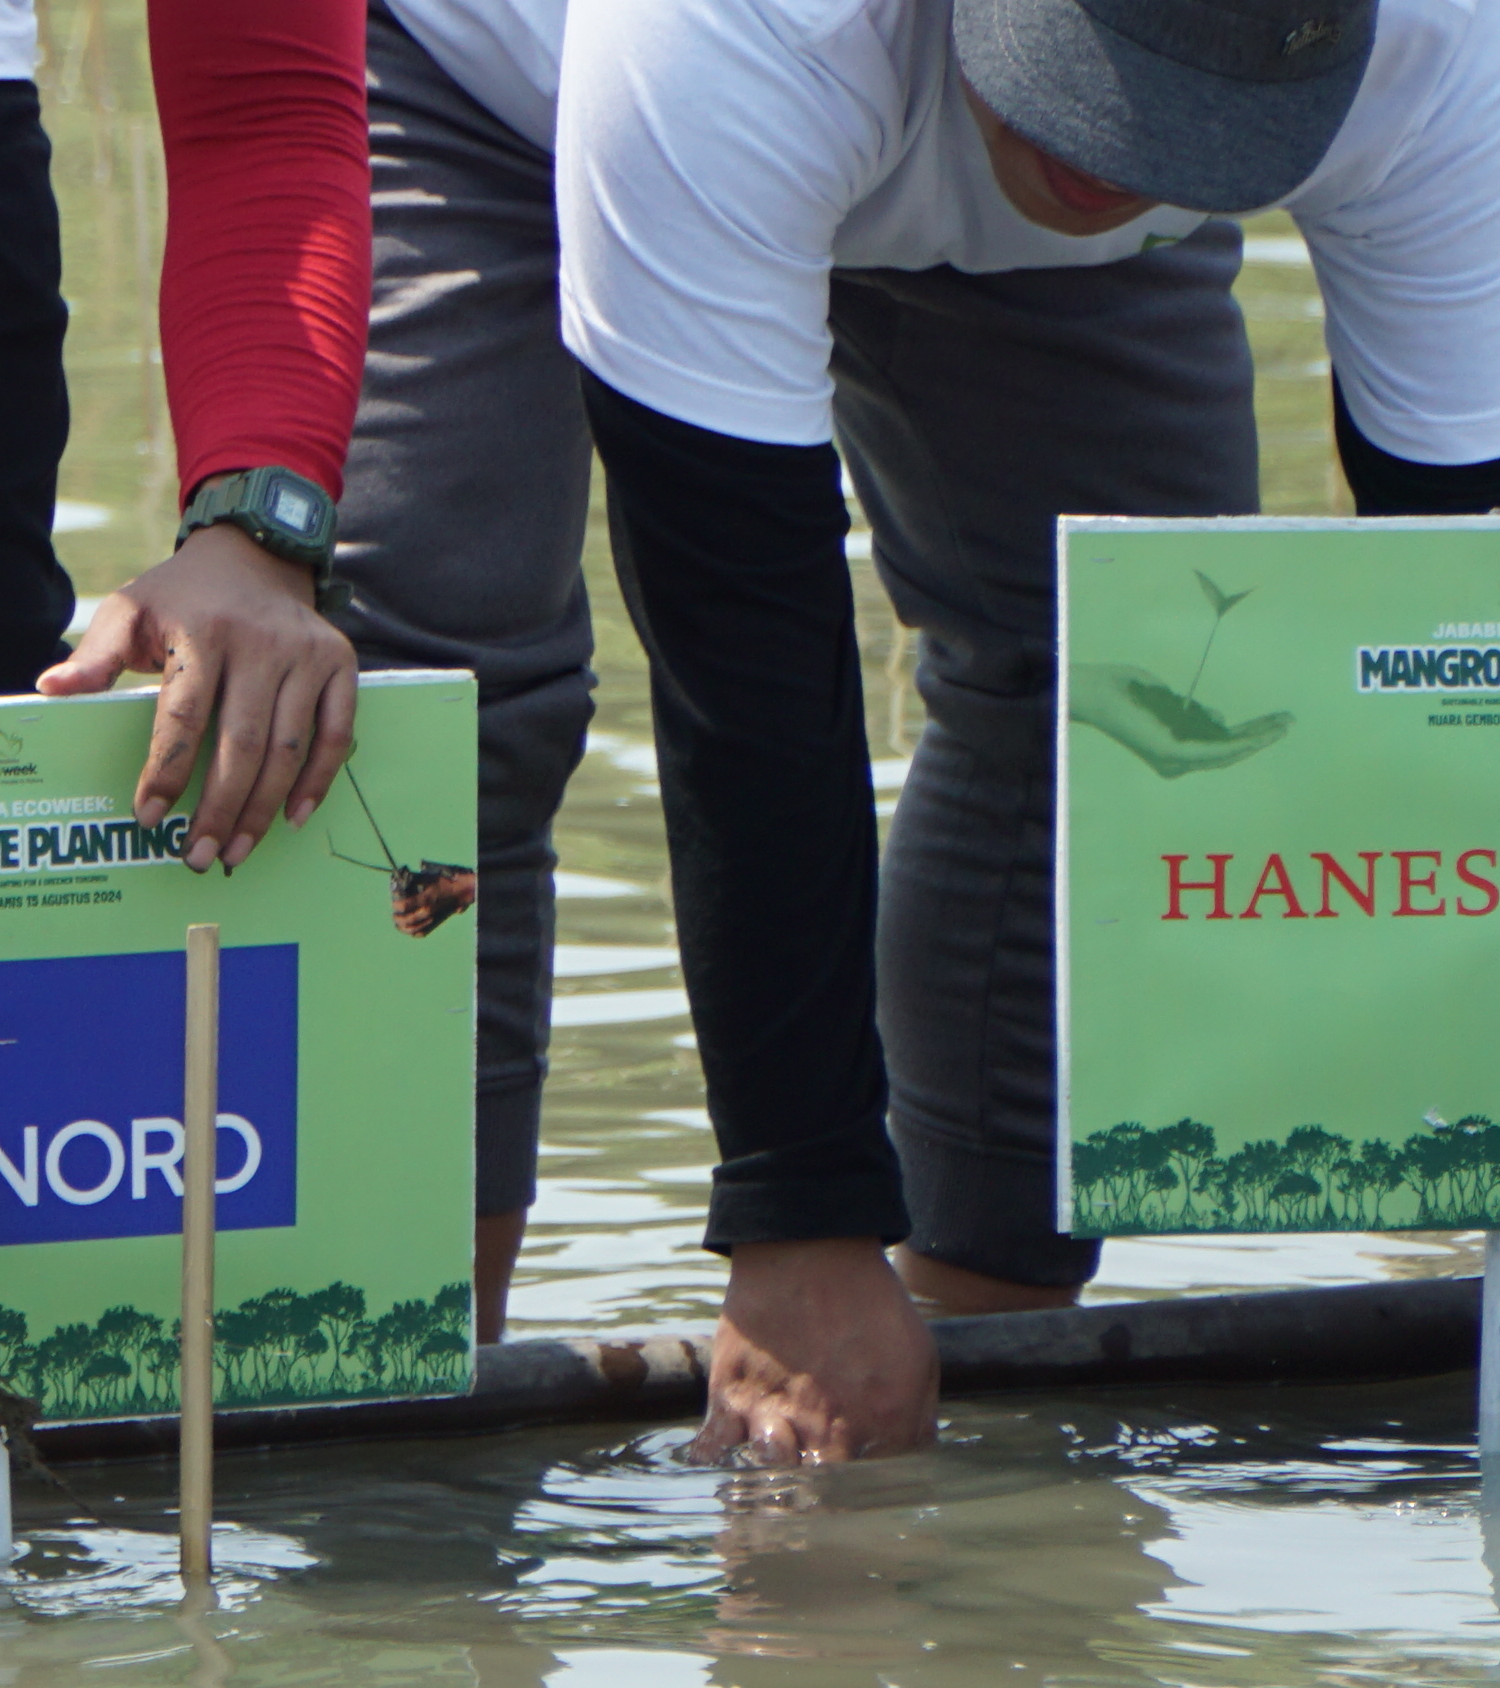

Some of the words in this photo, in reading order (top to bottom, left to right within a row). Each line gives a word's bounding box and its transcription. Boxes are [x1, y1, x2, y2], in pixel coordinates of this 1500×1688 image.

[1433, 622, 1500, 638] JABAB
[1360, 648, 1500, 688] MANGRO
[11, 796, 115, 817] ECOWEEK:
[1160, 849, 1500, 920] HANES
[41, 892, 90, 907] AGUSTUS
[93, 890, 122, 903] 2024
